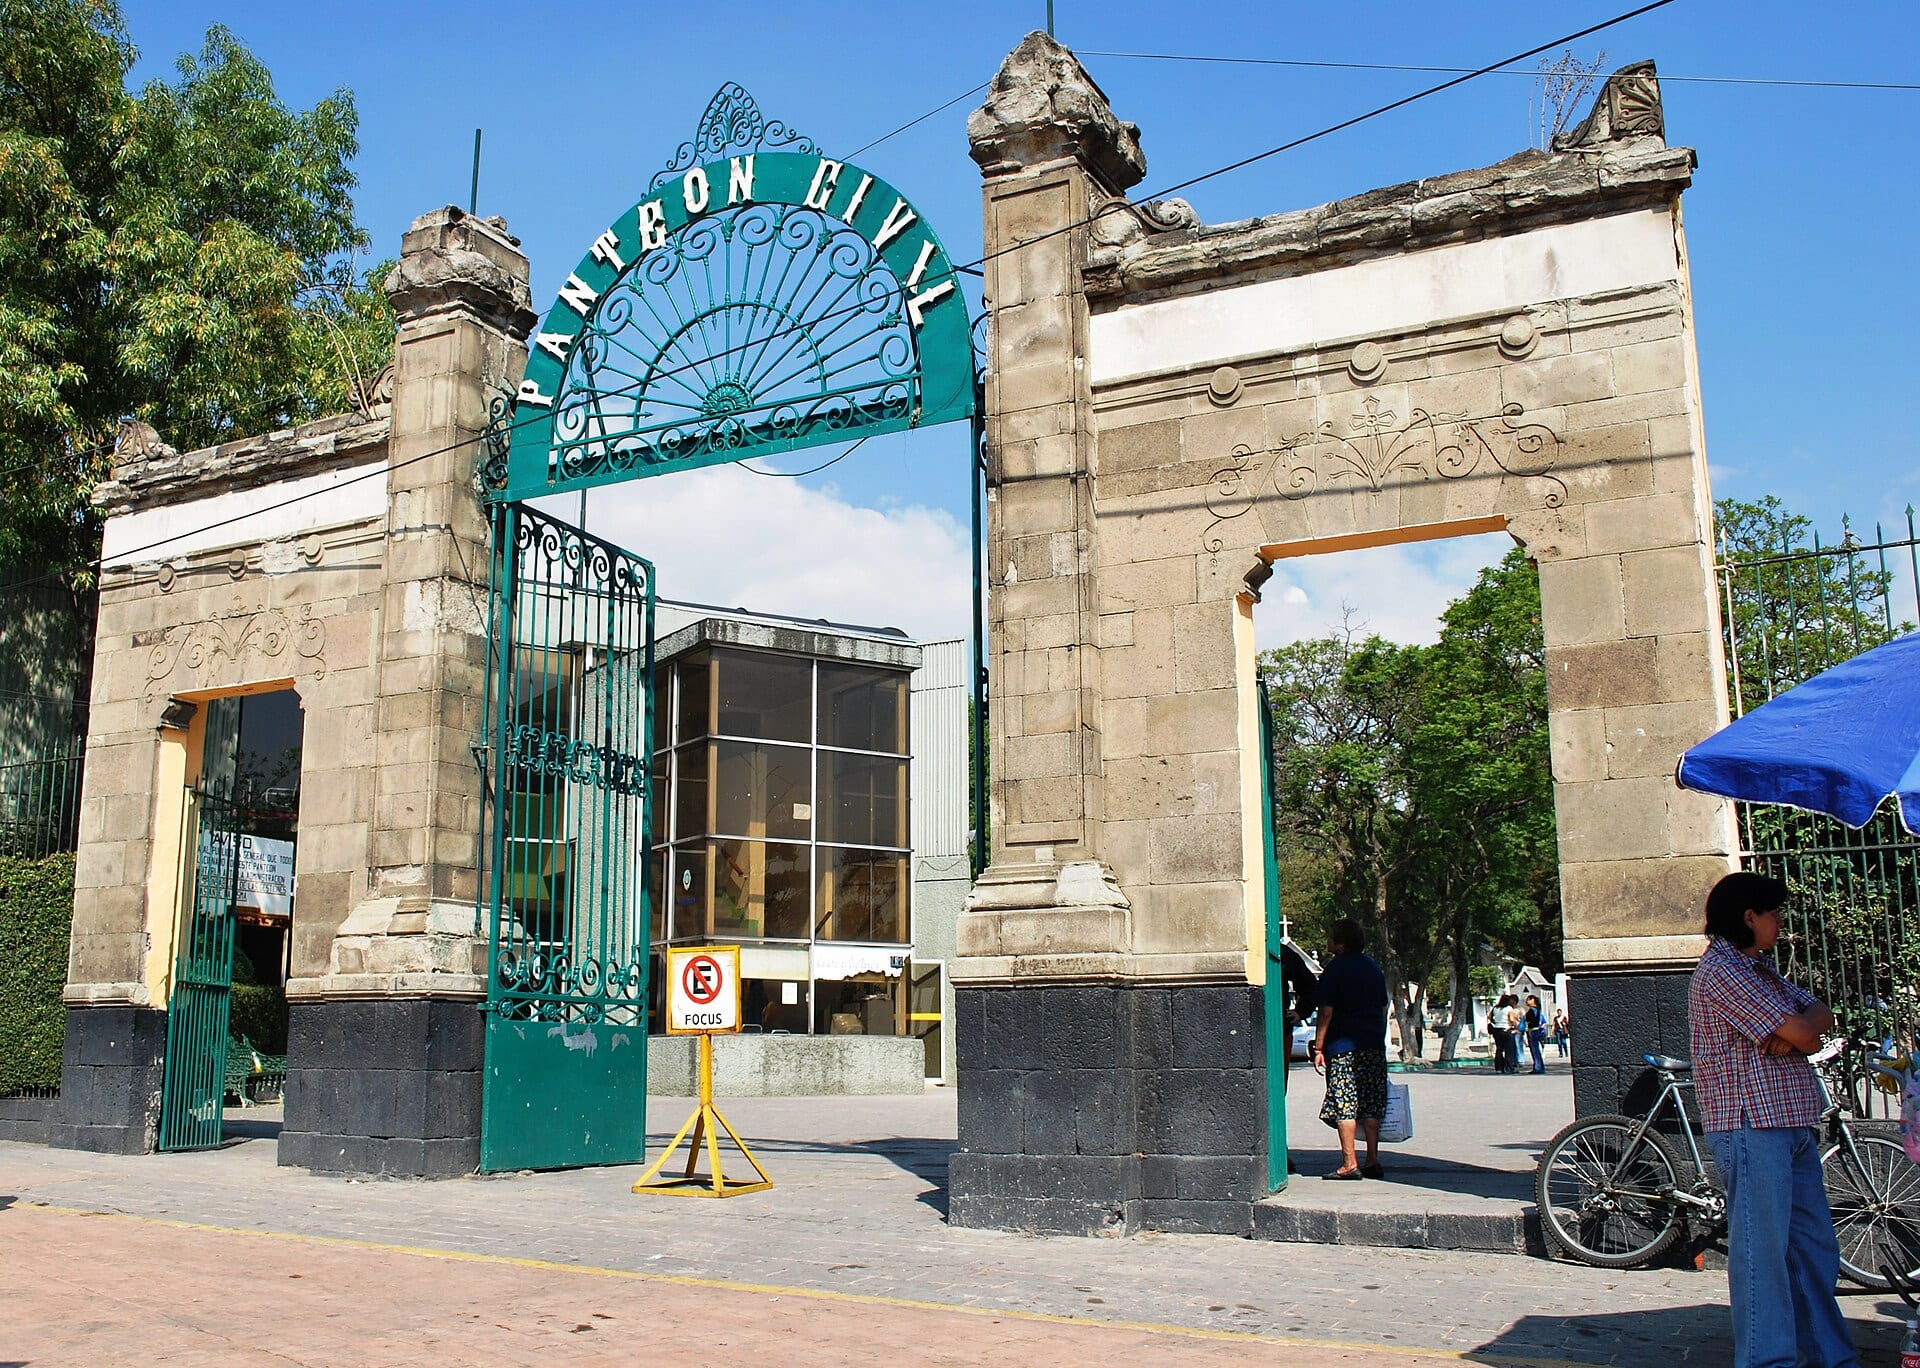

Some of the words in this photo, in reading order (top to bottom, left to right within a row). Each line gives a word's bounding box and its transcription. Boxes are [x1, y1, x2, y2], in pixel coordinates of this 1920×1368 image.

[517, 154, 757, 405] PANTEON
[803, 158, 956, 328] CIVIL
[212, 833, 252, 849] AVSO
[253, 862, 277, 872] PANTEON
[685, 1013, 722, 1026] FOCUS
